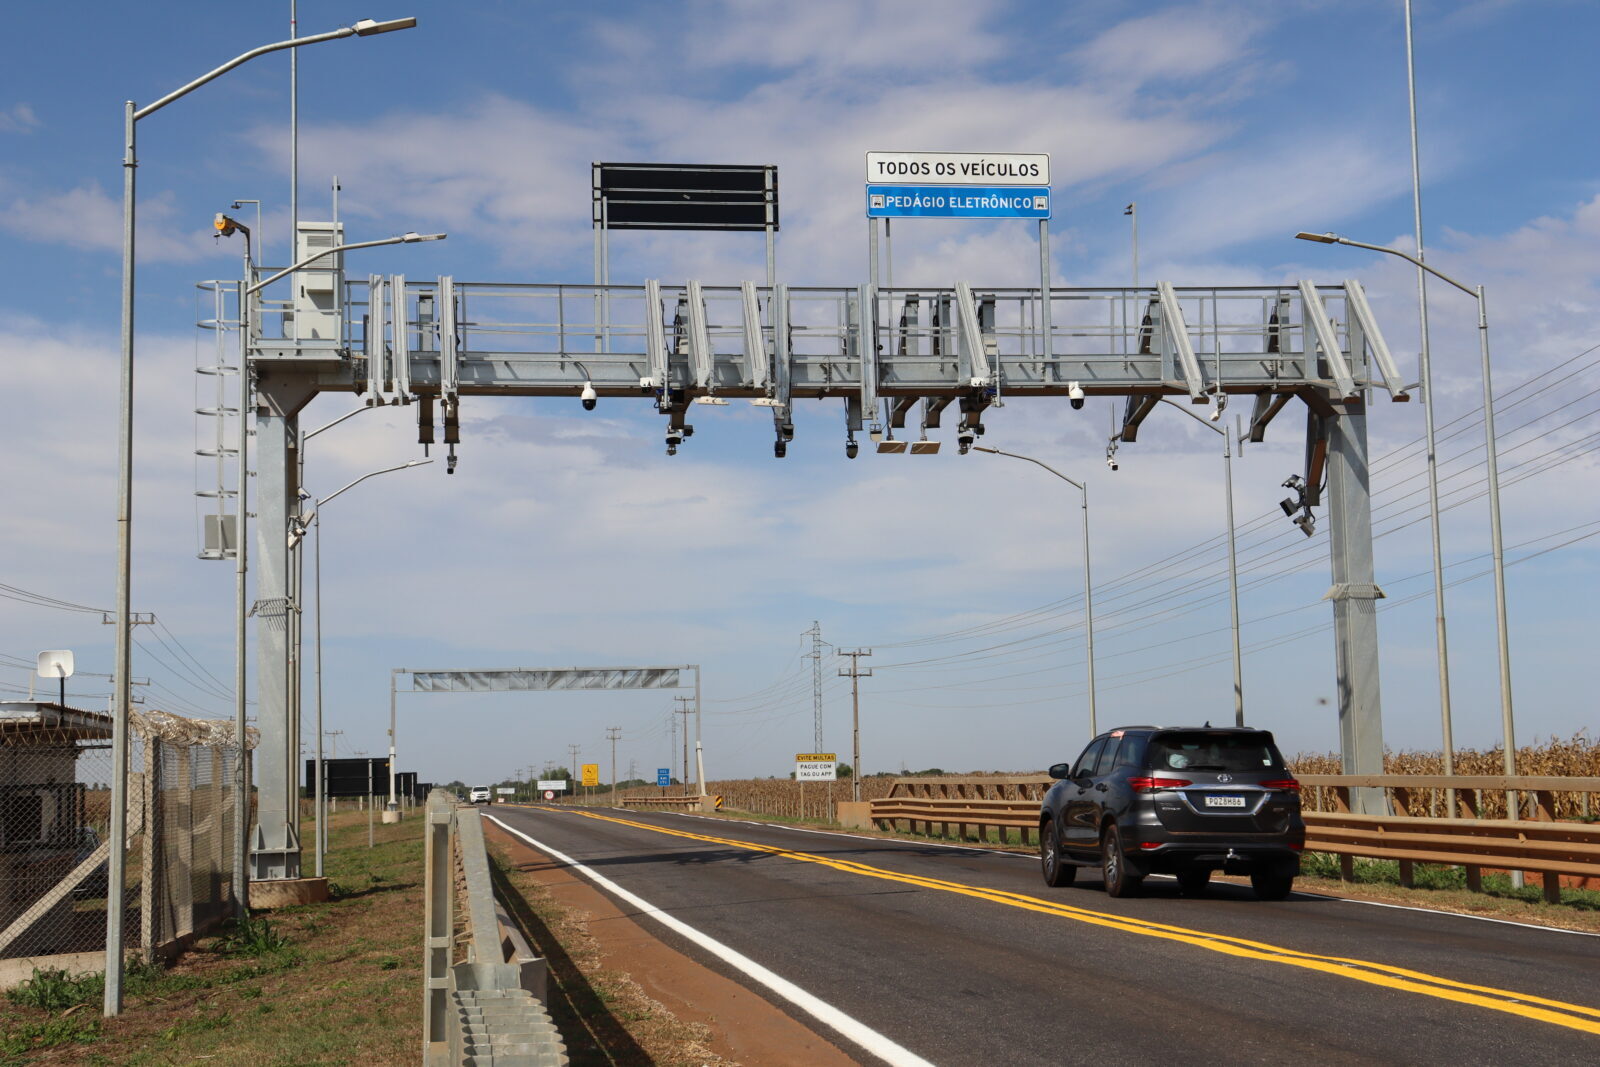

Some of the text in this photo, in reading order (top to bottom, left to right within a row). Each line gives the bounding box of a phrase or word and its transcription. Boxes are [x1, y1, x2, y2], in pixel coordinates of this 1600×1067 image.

[877, 159, 1039, 177] TODOS OS VEÍCULOS
[886, 193, 1032, 209] PEDÁGIO ELETRÔNICO
